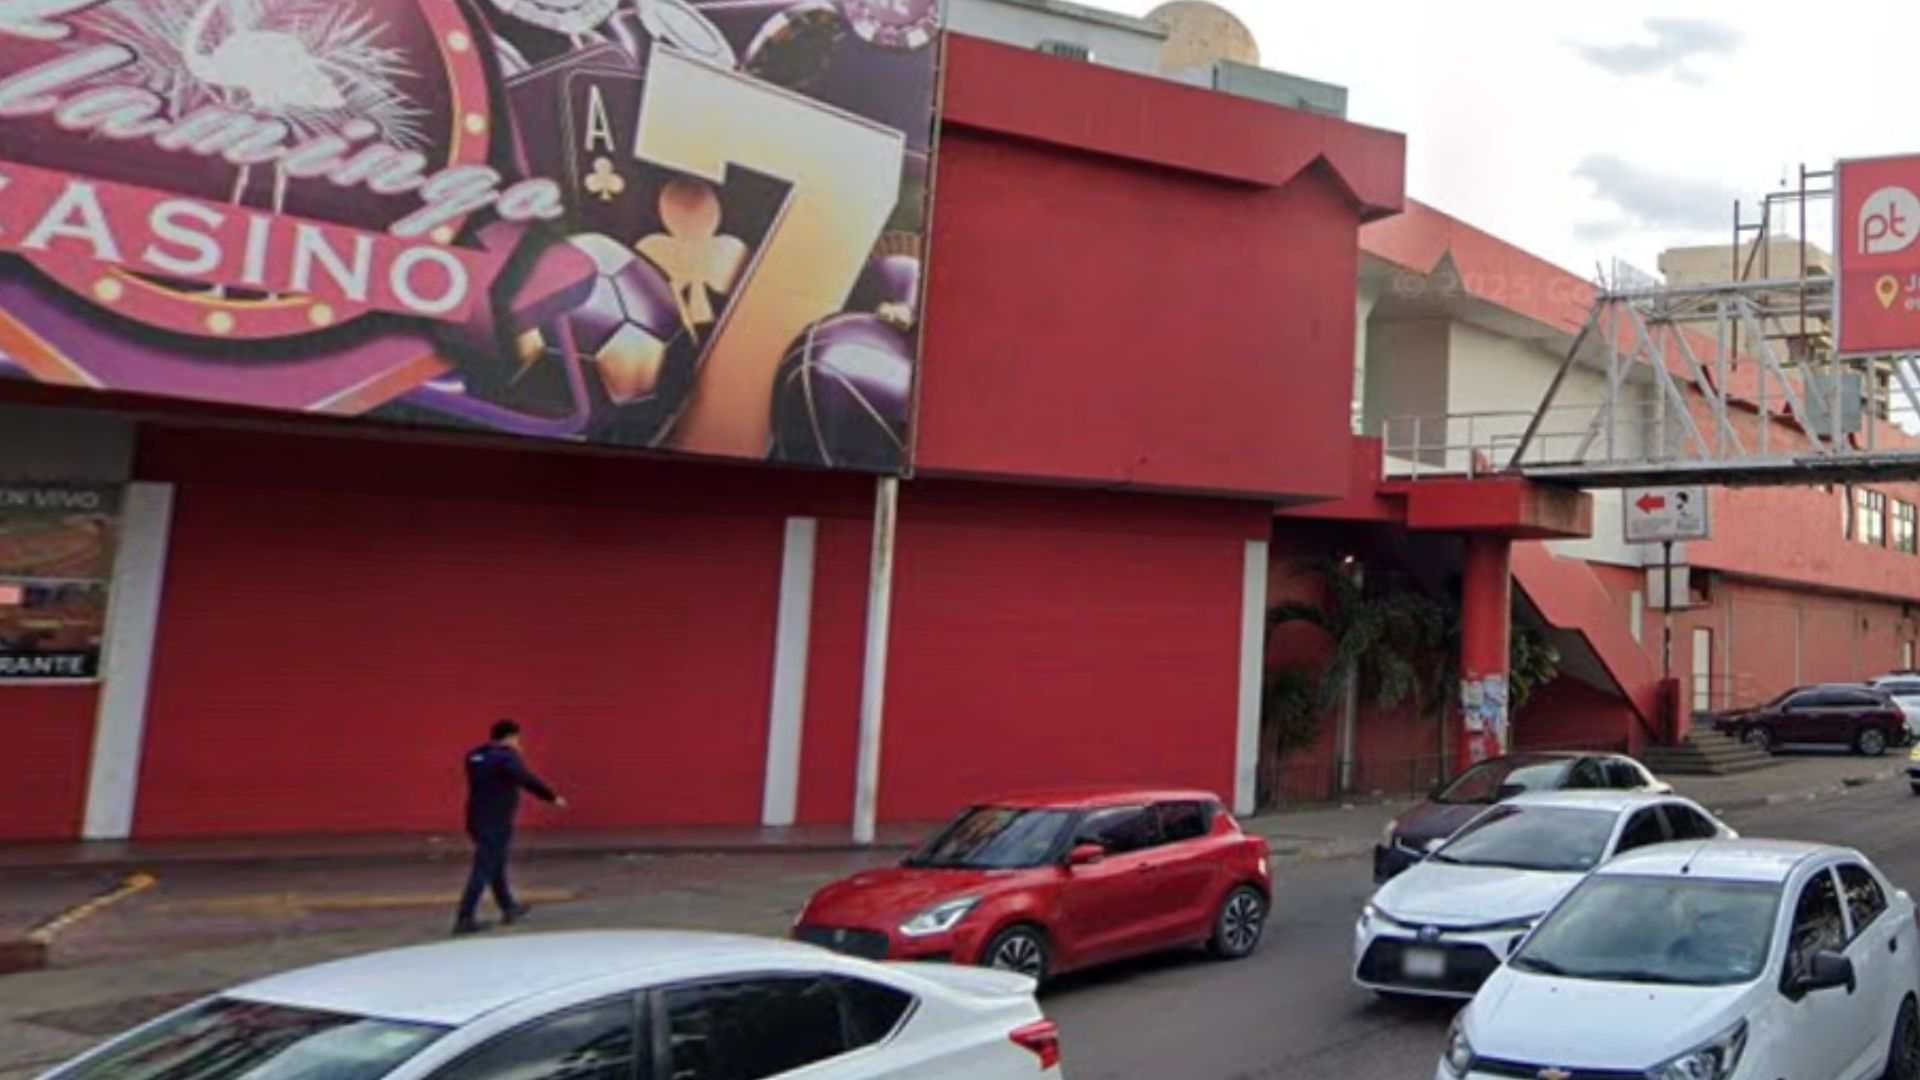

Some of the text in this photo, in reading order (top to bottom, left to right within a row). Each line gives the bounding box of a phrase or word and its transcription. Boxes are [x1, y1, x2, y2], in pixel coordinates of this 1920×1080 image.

[0, 0, 564, 236] lamingo
[585, 85, 615, 152] A
[0, 174, 469, 316] ASINO
[633, 42, 906, 458] 7
[1864, 201, 1906, 254] pt
